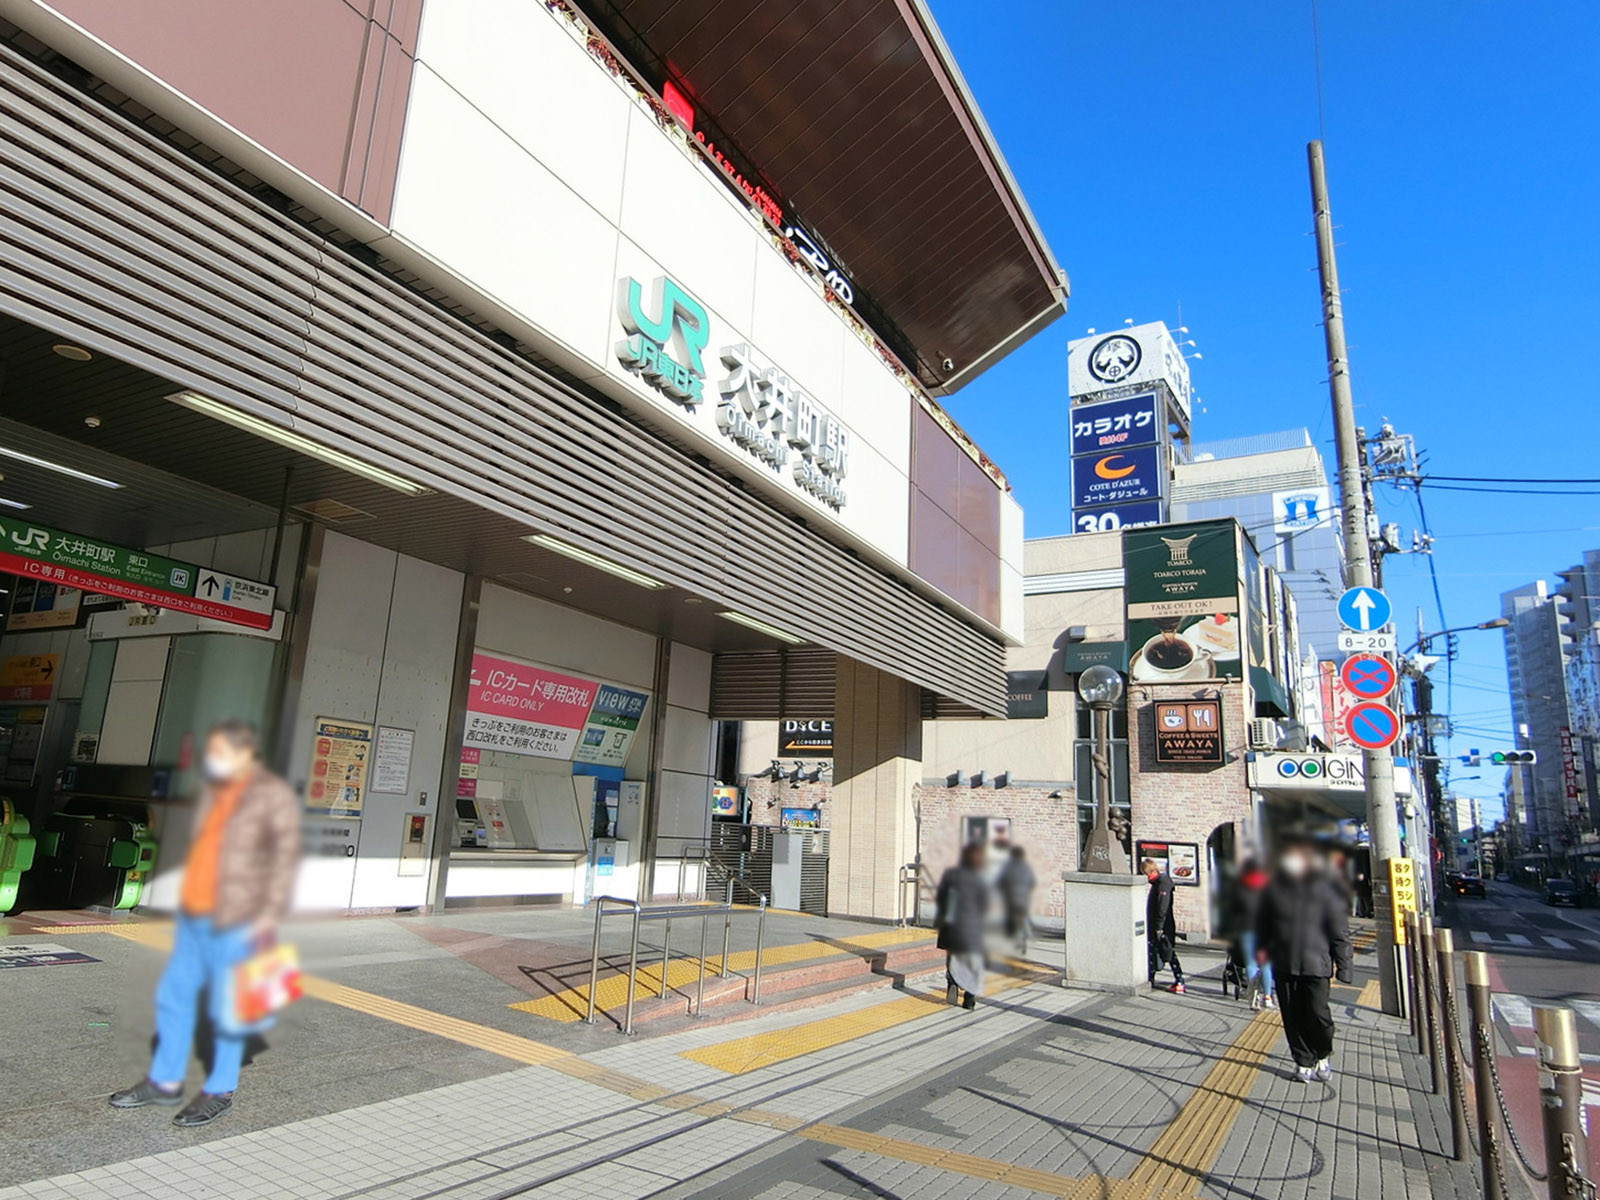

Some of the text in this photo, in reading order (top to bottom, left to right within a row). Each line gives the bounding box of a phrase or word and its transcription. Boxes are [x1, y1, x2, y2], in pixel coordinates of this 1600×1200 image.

[618, 275, 710, 379] JR
[621, 334, 704, 405] JR東日本
[719, 342, 850, 480] 大井町駅
[1074, 410, 1153, 437] カラオケ
[796, 460, 848, 506] Station
[11, 527, 50, 551] JR
[55, 536, 116, 563] 大井町駅
[24, 561, 66, 580] IC専用
[91, 561, 121, 575] Station
[128, 554, 149, 568] 東口
[1167, 559, 1193, 567] TOARCO
[1181, 569, 1207, 577] TORAJA
[173, 573, 185, 583] JK
[1151, 603, 1172, 611] TAKE
[486, 669, 590, 708] ICカード専用改札
[481, 690, 545, 712] IC CARD ONLY
[465, 729, 560, 753] 西口改札をご利用ください。
[471, 717, 568, 742] きっぷをご利用のお客さまは
[1164, 740, 1214, 748] AWAYA
